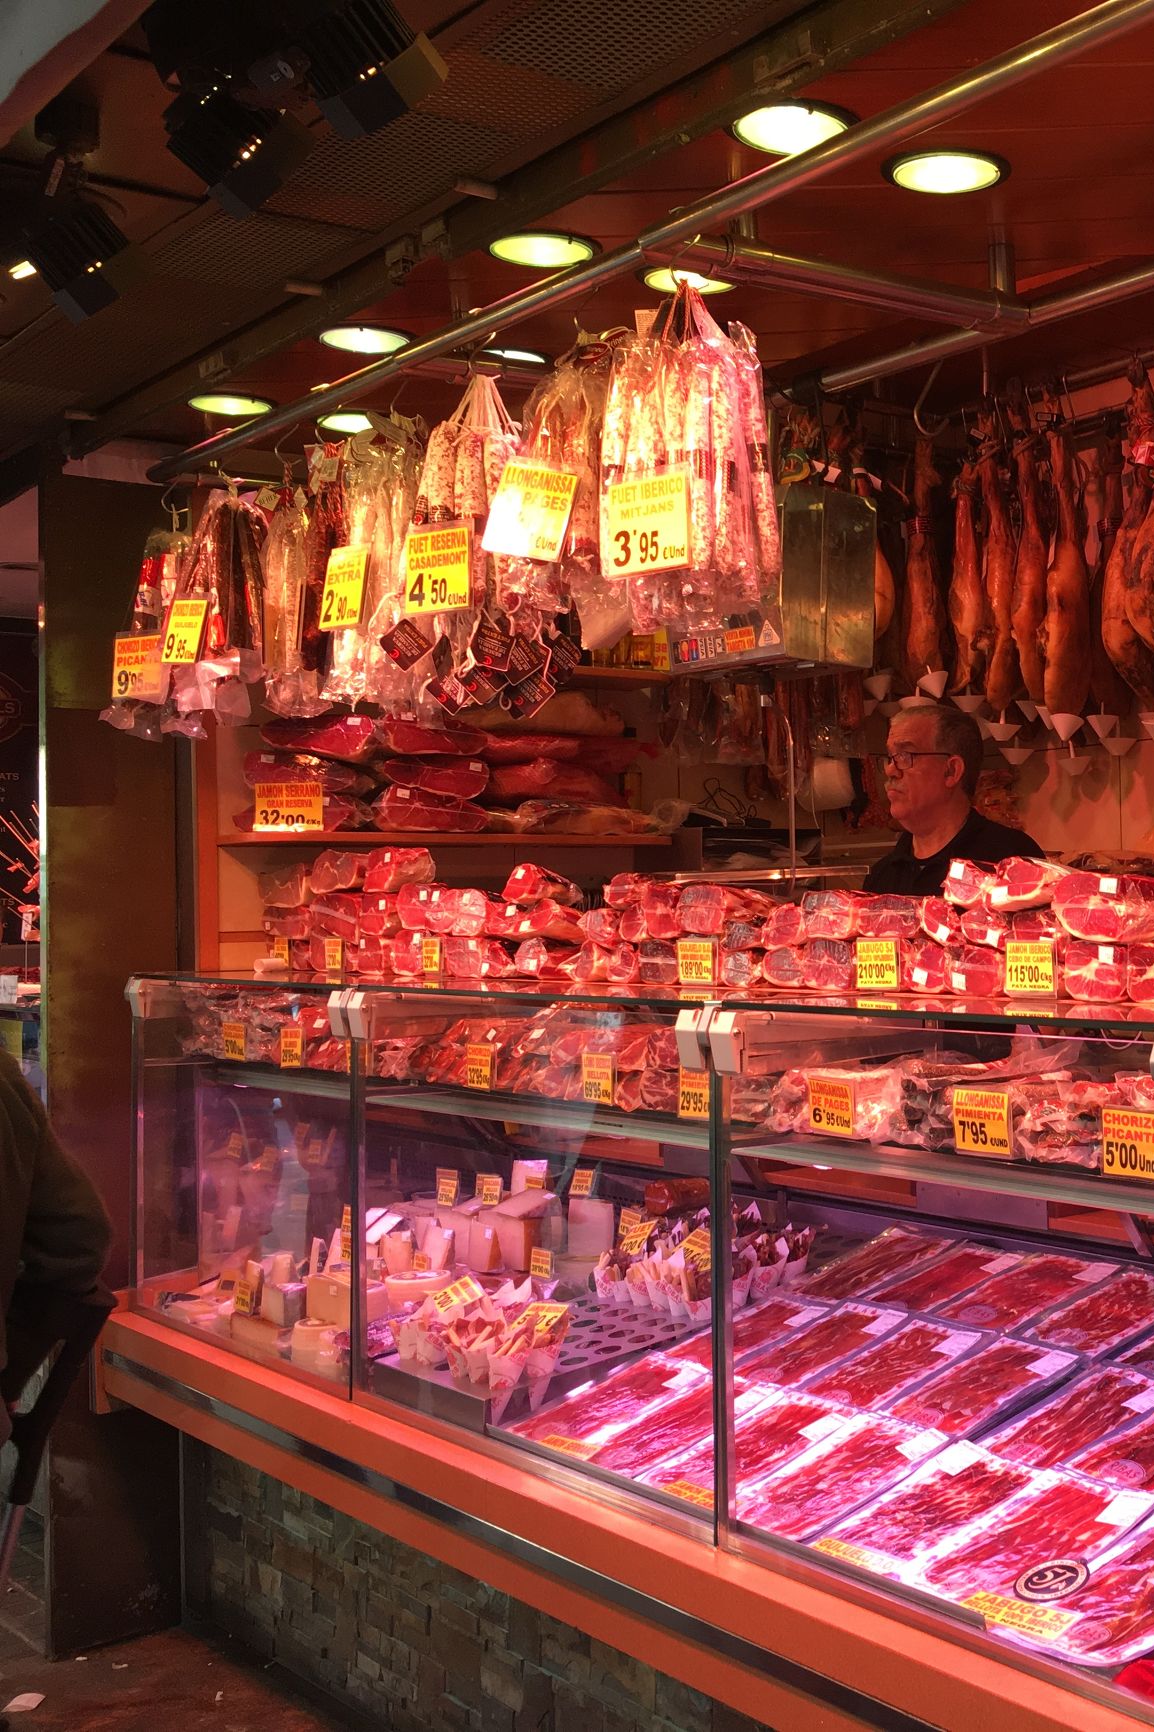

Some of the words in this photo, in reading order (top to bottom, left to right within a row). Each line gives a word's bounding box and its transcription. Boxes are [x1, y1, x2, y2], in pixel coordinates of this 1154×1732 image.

[505, 466, 574, 495] LLONGANISSA
[611, 485, 637, 505] FUET
[640, 477, 683, 497] IBERICO
[409, 537, 428, 555] FUET
[431, 531, 467, 551] RESERVA
[613, 530, 659, 567] 3'95
[409, 551, 467, 571] CASADEMONT
[328, 569, 361, 585] EXTRA
[409, 573, 447, 607] 4'50
[323, 589, 347, 623] 2'90
[165, 634, 186, 659] 9'95
[257, 785, 283, 798] JAMON
[285, 785, 320, 797] SERRANO
[267, 800, 284, 808] GRAN
[286, 799, 312, 808] RESERVA
[260, 810, 305, 826] 32'00
[858, 943, 884, 953] JABUGO
[1009, 945, 1027, 954] JAMON
[1029, 945, 1051, 954] IBERICO
[680, 962, 703, 976] 189'00
[858, 963, 885, 979] 210'00
[1009, 965, 1040, 982] 115'00
[468, 1067, 483, 1085] 32'95
[586, 1070, 610, 1081] BELLOTA
[584, 1080, 601, 1099] 69'95
[810, 1079, 849, 1100] LLONGANISSA
[681, 1091, 703, 1113] 29'95
[812, 1096, 822, 1106] DE
[823, 1098, 849, 1112] PAGES
[956, 1089, 1005, 1110] LLONGANISSA
[813, 1107, 835, 1125] 6'95
[955, 1108, 1004, 1122] PIMIENTA
[959, 1121, 988, 1145] 7'95
[1106, 1141, 1137, 1170] 5'00
[819, 1540, 872, 1563] GUIJUELO
[964, 1600, 1000, 1615] BELLOTA
[1026, 1617, 1063, 1632] IBERICO
[974, 1594, 1048, 1618] JABUGO
[1049, 1613, 1070, 1625] 5J
[1000, 1618, 1043, 1634] NEGRA
